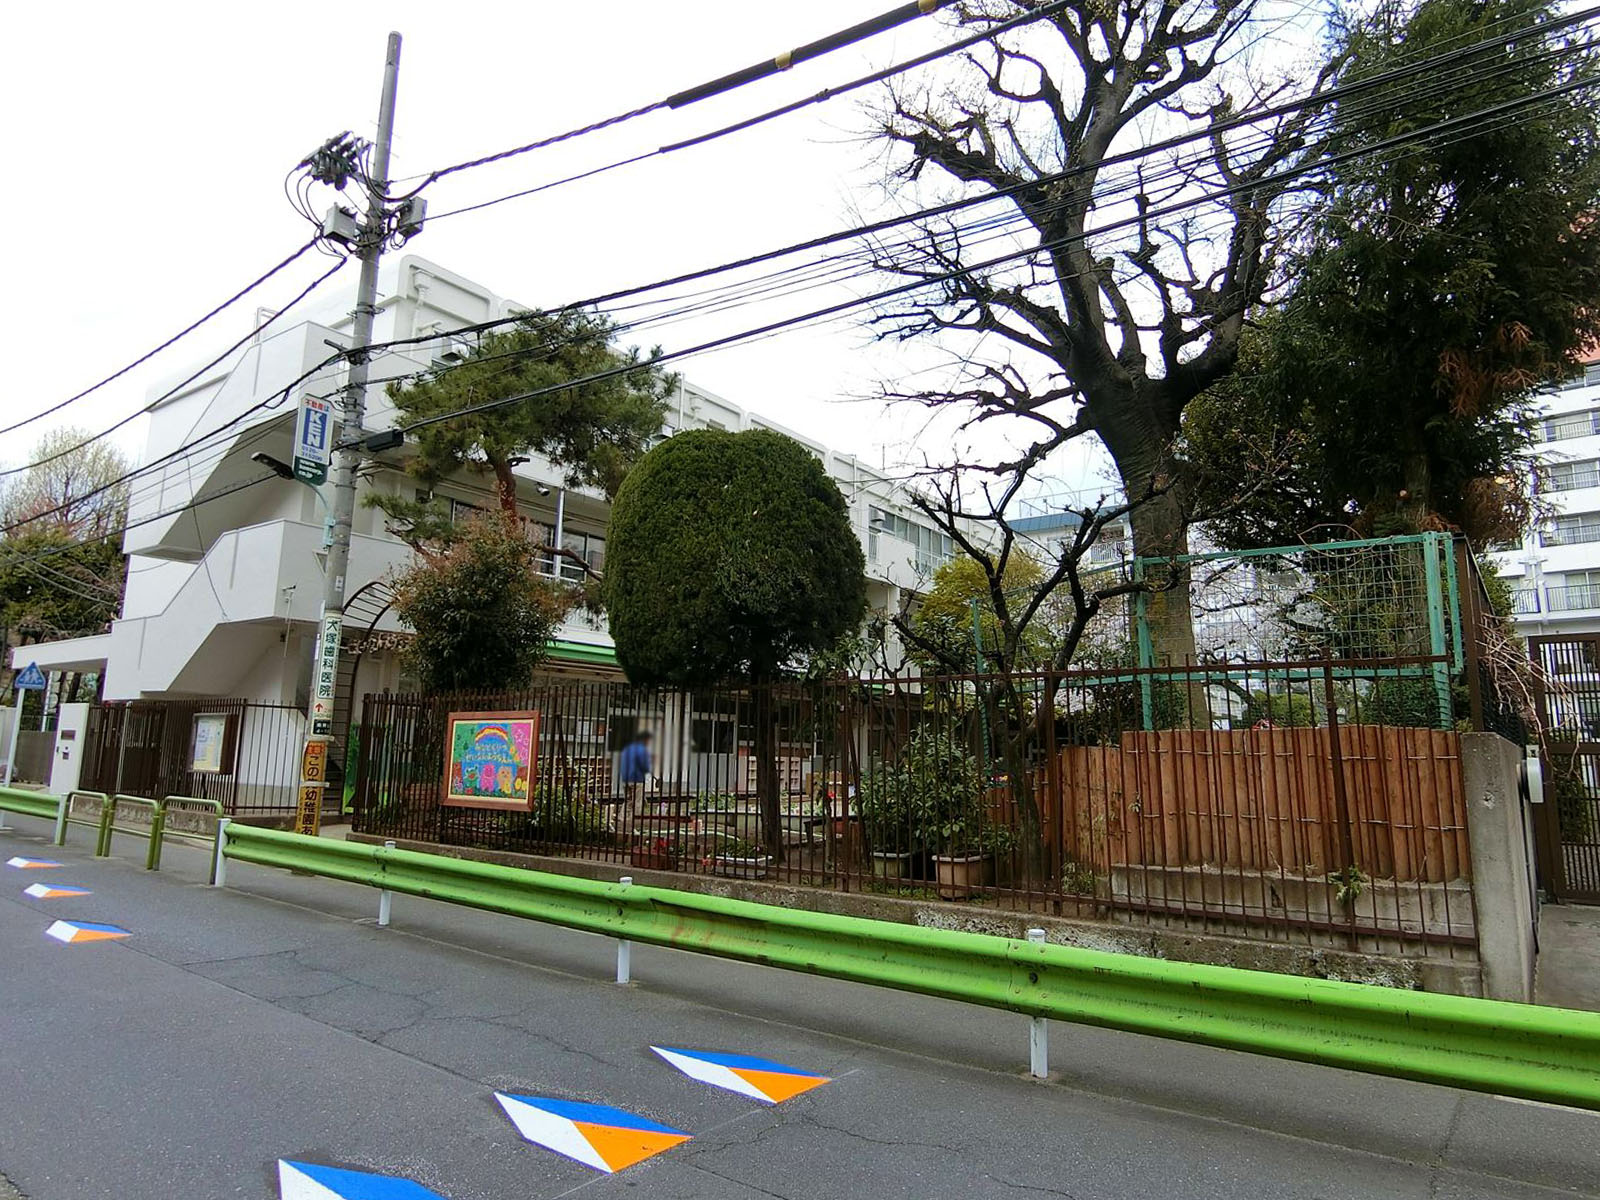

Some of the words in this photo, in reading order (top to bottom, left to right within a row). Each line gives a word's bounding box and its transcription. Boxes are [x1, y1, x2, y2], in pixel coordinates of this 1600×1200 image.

[306, 410, 322, 447] KEN
[319, 619, 338, 697] 大塚歯科医院
